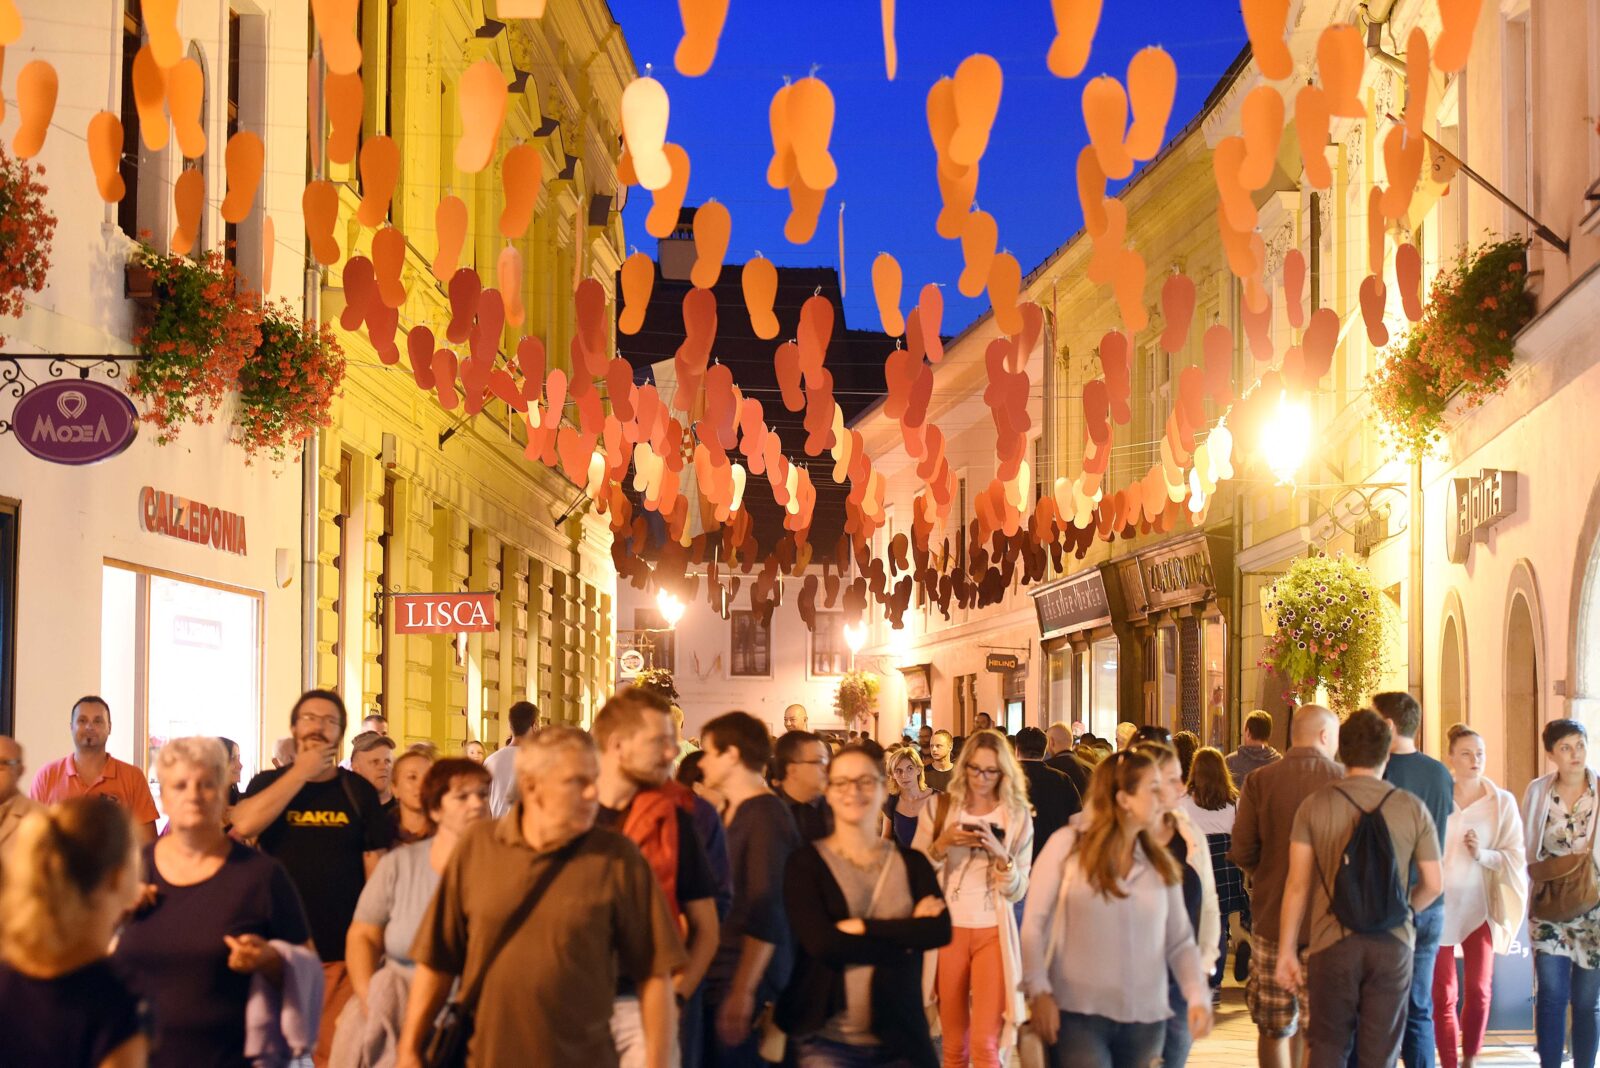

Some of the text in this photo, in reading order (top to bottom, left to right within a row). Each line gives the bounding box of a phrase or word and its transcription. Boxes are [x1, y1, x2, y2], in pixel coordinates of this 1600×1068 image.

[139, 486, 247, 556] CALZEDONIA
[404, 600, 491, 627] LISCA
[286, 810, 350, 825] RAKIA
